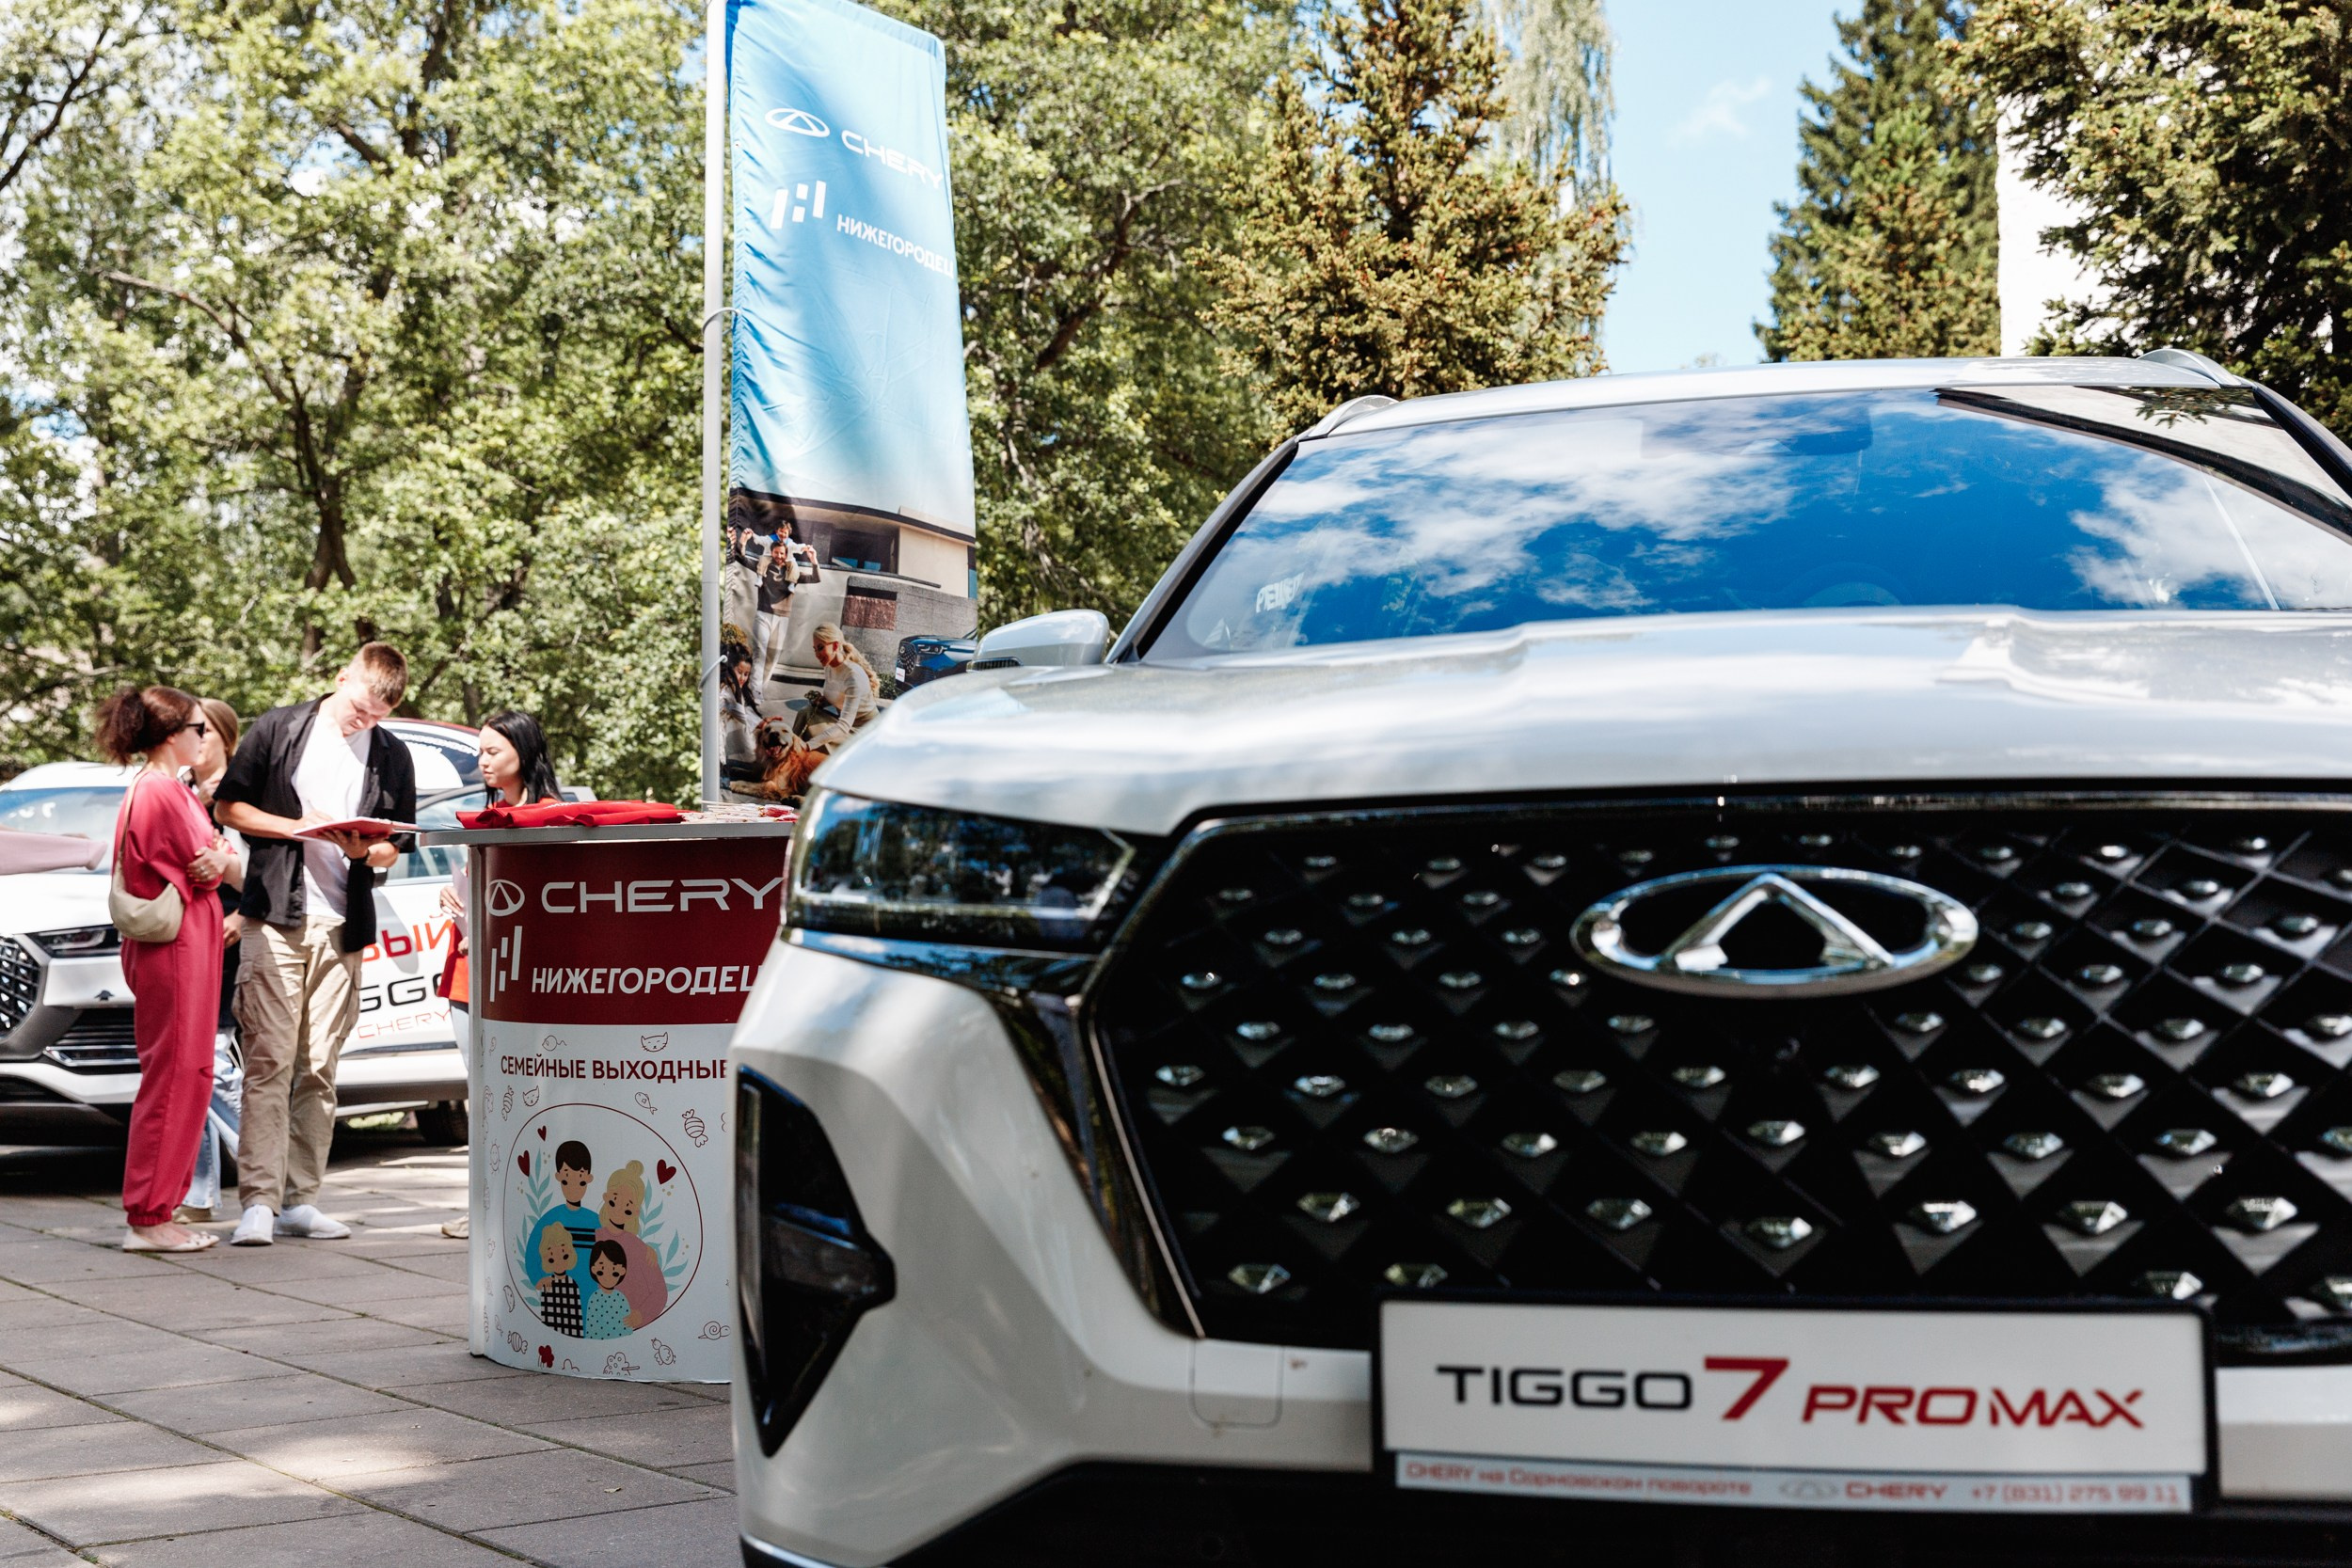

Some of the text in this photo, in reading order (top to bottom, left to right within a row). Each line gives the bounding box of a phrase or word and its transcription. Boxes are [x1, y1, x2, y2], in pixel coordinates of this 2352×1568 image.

[841, 130, 944, 188] CHERY
[836, 214, 954, 278] НИЖЕГОРОДЕЦ
[541, 878, 785, 913] CHERY
[358, 1009, 450, 1038] CHERY
[501, 1053, 586, 1079] СЕМЕЙНЫЕ
[1437, 1365, 1692, 1411] TIGGO
[1704, 1355, 1789, 1421] 7
[1406, 1462, 1475, 1483] CHERY
[1846, 1481, 1947, 1501] CHERY
